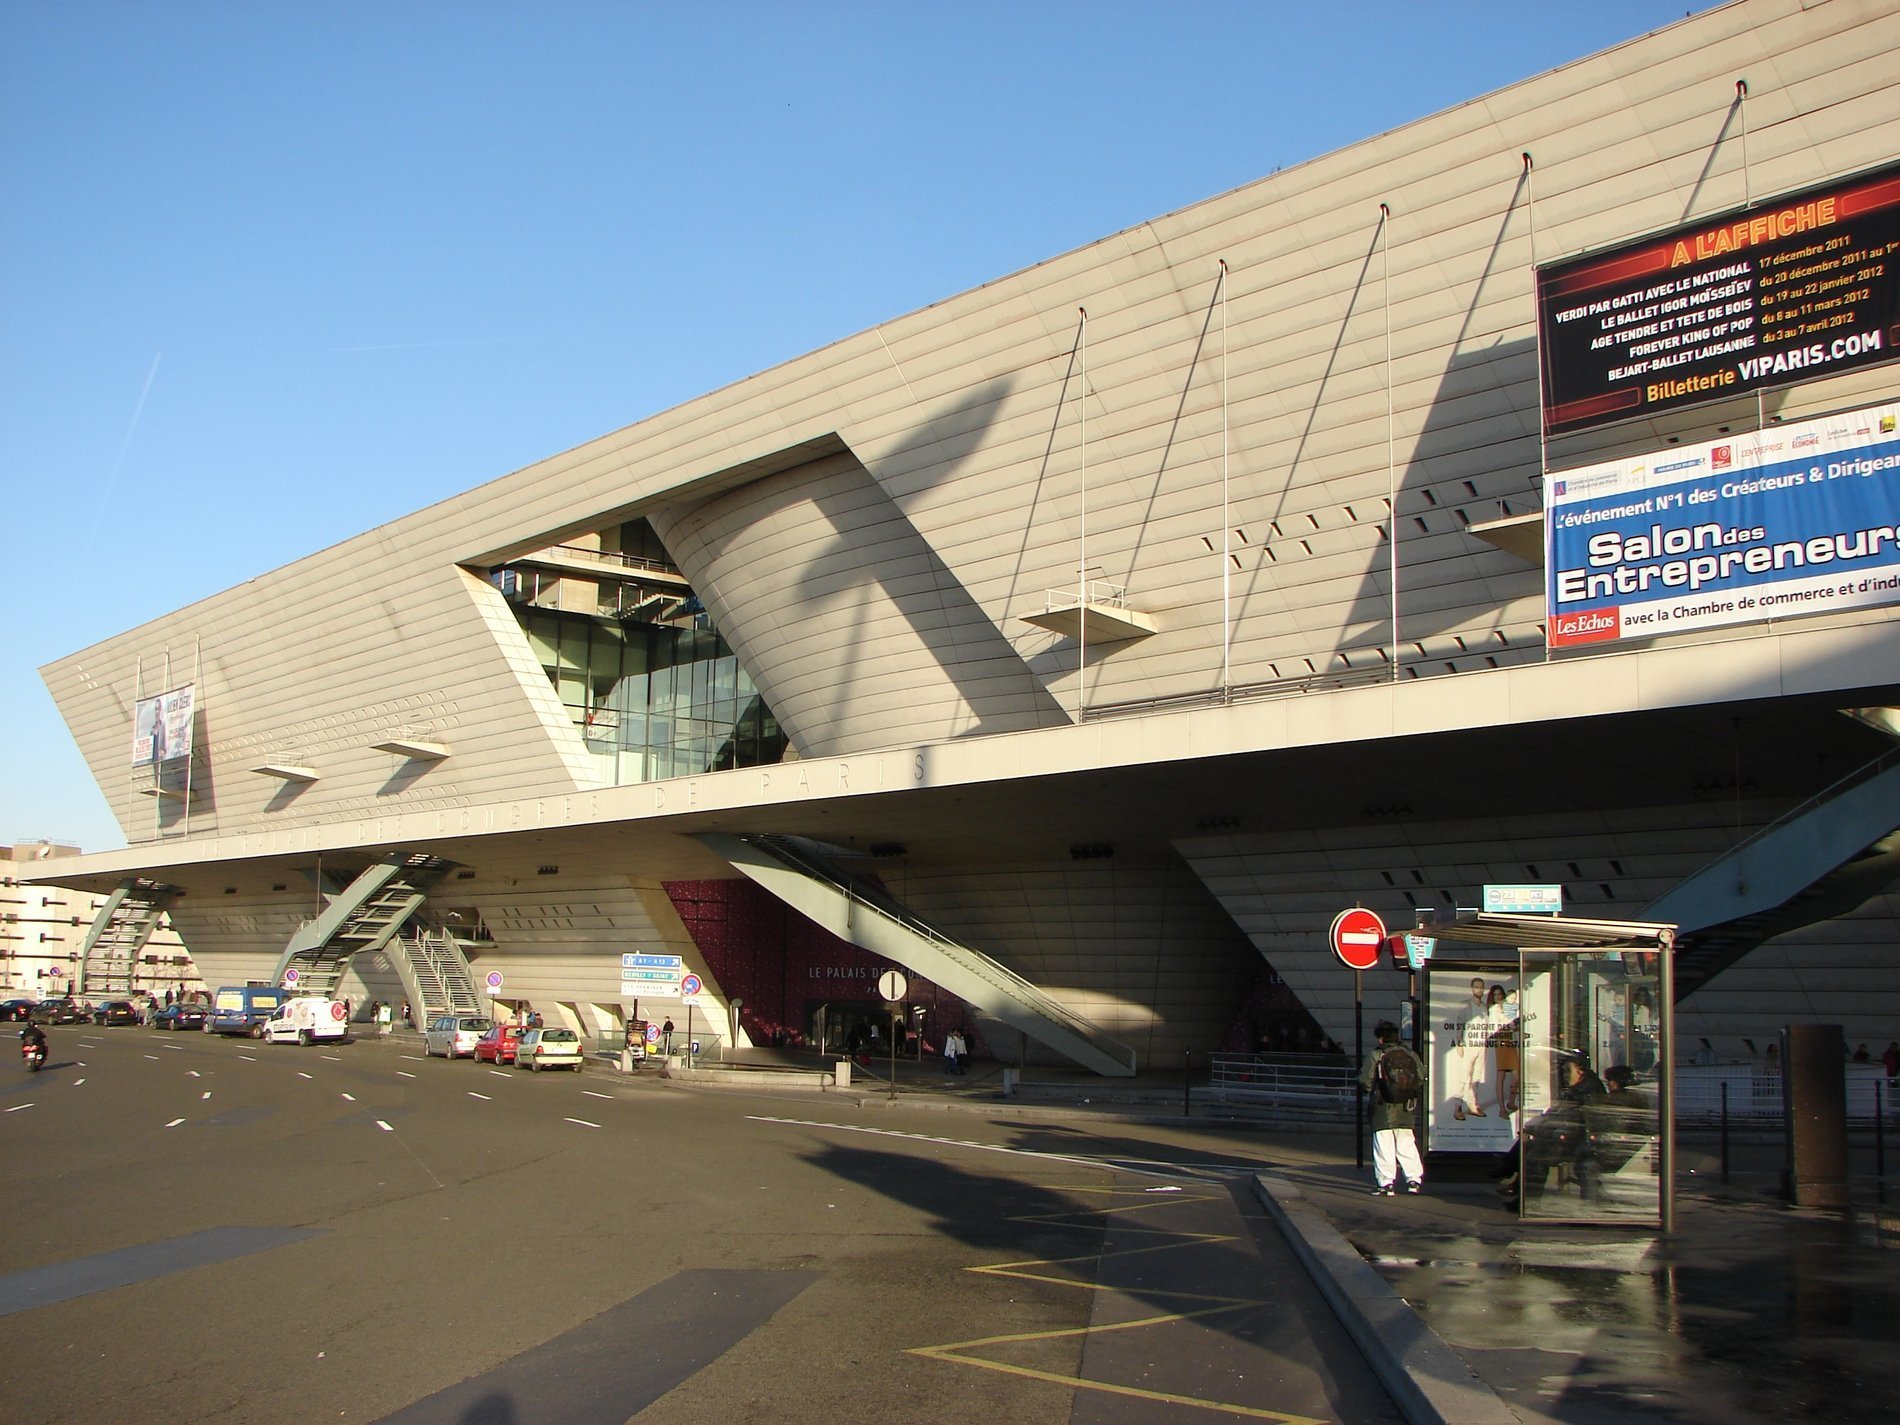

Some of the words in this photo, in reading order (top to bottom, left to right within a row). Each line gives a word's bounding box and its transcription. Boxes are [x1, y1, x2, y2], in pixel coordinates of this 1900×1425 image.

[1671, 241, 1691, 268] A
[1696, 198, 1837, 261] L'AFFICHE
[1759, 257, 1771, 269] 17
[1773, 245, 1823, 266] décembre
[1825, 235, 1851, 252] 2011
[1759, 276, 1773, 288] du
[1774, 272, 1788, 285] 20
[1789, 259, 1839, 280] décembre
[1841, 251, 1867, 267] 2011
[1869, 247, 1883, 258] au
[1760, 295, 1774, 307] du
[1776, 290, 1788, 303] 19
[1790, 287, 1803, 299] au
[1805, 283, 1818, 295] 22
[1819, 273, 1855, 294] janvier
[1857, 265, 1885, 281] 2012
[1556, 306, 1587, 323] VERDI
[1589, 300, 1611, 315] PAR
[1612, 291, 1644, 309] GATTI
[1645, 282, 1675, 300] AVEC
[1676, 278, 1691, 292] LE
[1692, 262, 1751, 288] NATIONAL
[1601, 315, 1616, 330] LE
[1617, 304, 1659, 326] BALLET
[1661, 297, 1688, 314] IGOR
[1689, 279, 1752, 307] MOÏSSEÏEV
[1761, 313, 1775, 325] du
[1776, 311, 1784, 321] 8
[1785, 308, 1798, 320] au
[1800, 303, 1813, 316] 11
[1814, 297, 1842, 312] mars
[1843, 289, 1870, 304] 2012
[1590, 334, 1613, 350] AGE
[1614, 322, 1659, 344] TENDRE
[1660, 318, 1676, 333] ET
[1676, 310, 1706, 329] TETE
[1708, 306, 1724, 320] DE
[1725, 298, 1753, 316] BOIS
[1629, 334, 1680, 358] FOREVER
[1682, 328, 1710, 345] KING
[1711, 323, 1728, 337] OF
[1730, 317, 1754, 333] POP
[1762, 332, 1776, 344] du
[1776, 330, 1784, 340] 3
[1785, 327, 1797, 339] au
[1798, 324, 1806, 335] 7
[1806, 319, 1828, 333] avril
[1830, 311, 1855, 327] 2012
[1608, 351, 1694, 382] BEJART-BALLET
[1695, 335, 1756, 360] LAUSANNE
[1647, 368, 1736, 402] Billetterie
[1738, 329, 1881, 381] VIPARIS.COM
[1555, 501, 1653, 530] L'événement
[1656, 493, 1683, 512] N°1
[1687, 488, 1717, 506] des
[1720, 471, 1804, 499] Créateurs
[1808, 467, 1825, 483] &
[1557, 525, 1900, 603] Entrepreneur
[1588, 523, 1723, 568] Salon
[1723, 526, 1766, 546] des
[1624, 612, 1654, 626] avec
[1657, 609, 1669, 621] la
[1673, 601, 1735, 619] Chambre
[1738, 597, 1755, 609] de
[1759, 586, 1834, 606] commerce
[1838, 582, 1854, 596] et
[1858, 574, 1900, 593] d'ind
[1557, 618, 1577, 635] Les
[1577, 613, 1615, 632] Echos
[655, 781, 697, 809] DE
[760, 753, 925, 797] PARIS
[809, 967, 821, 978] LE
[826, 967, 866, 978] PALAIS
[872, 967, 893, 978] DE
[1444, 1023, 1455, 1031] ON
[1497, 1023, 1510, 1031] DES
[1467, 1031, 1479, 1039] ON
[1468, 1040, 1498, 1048] BANQUE
